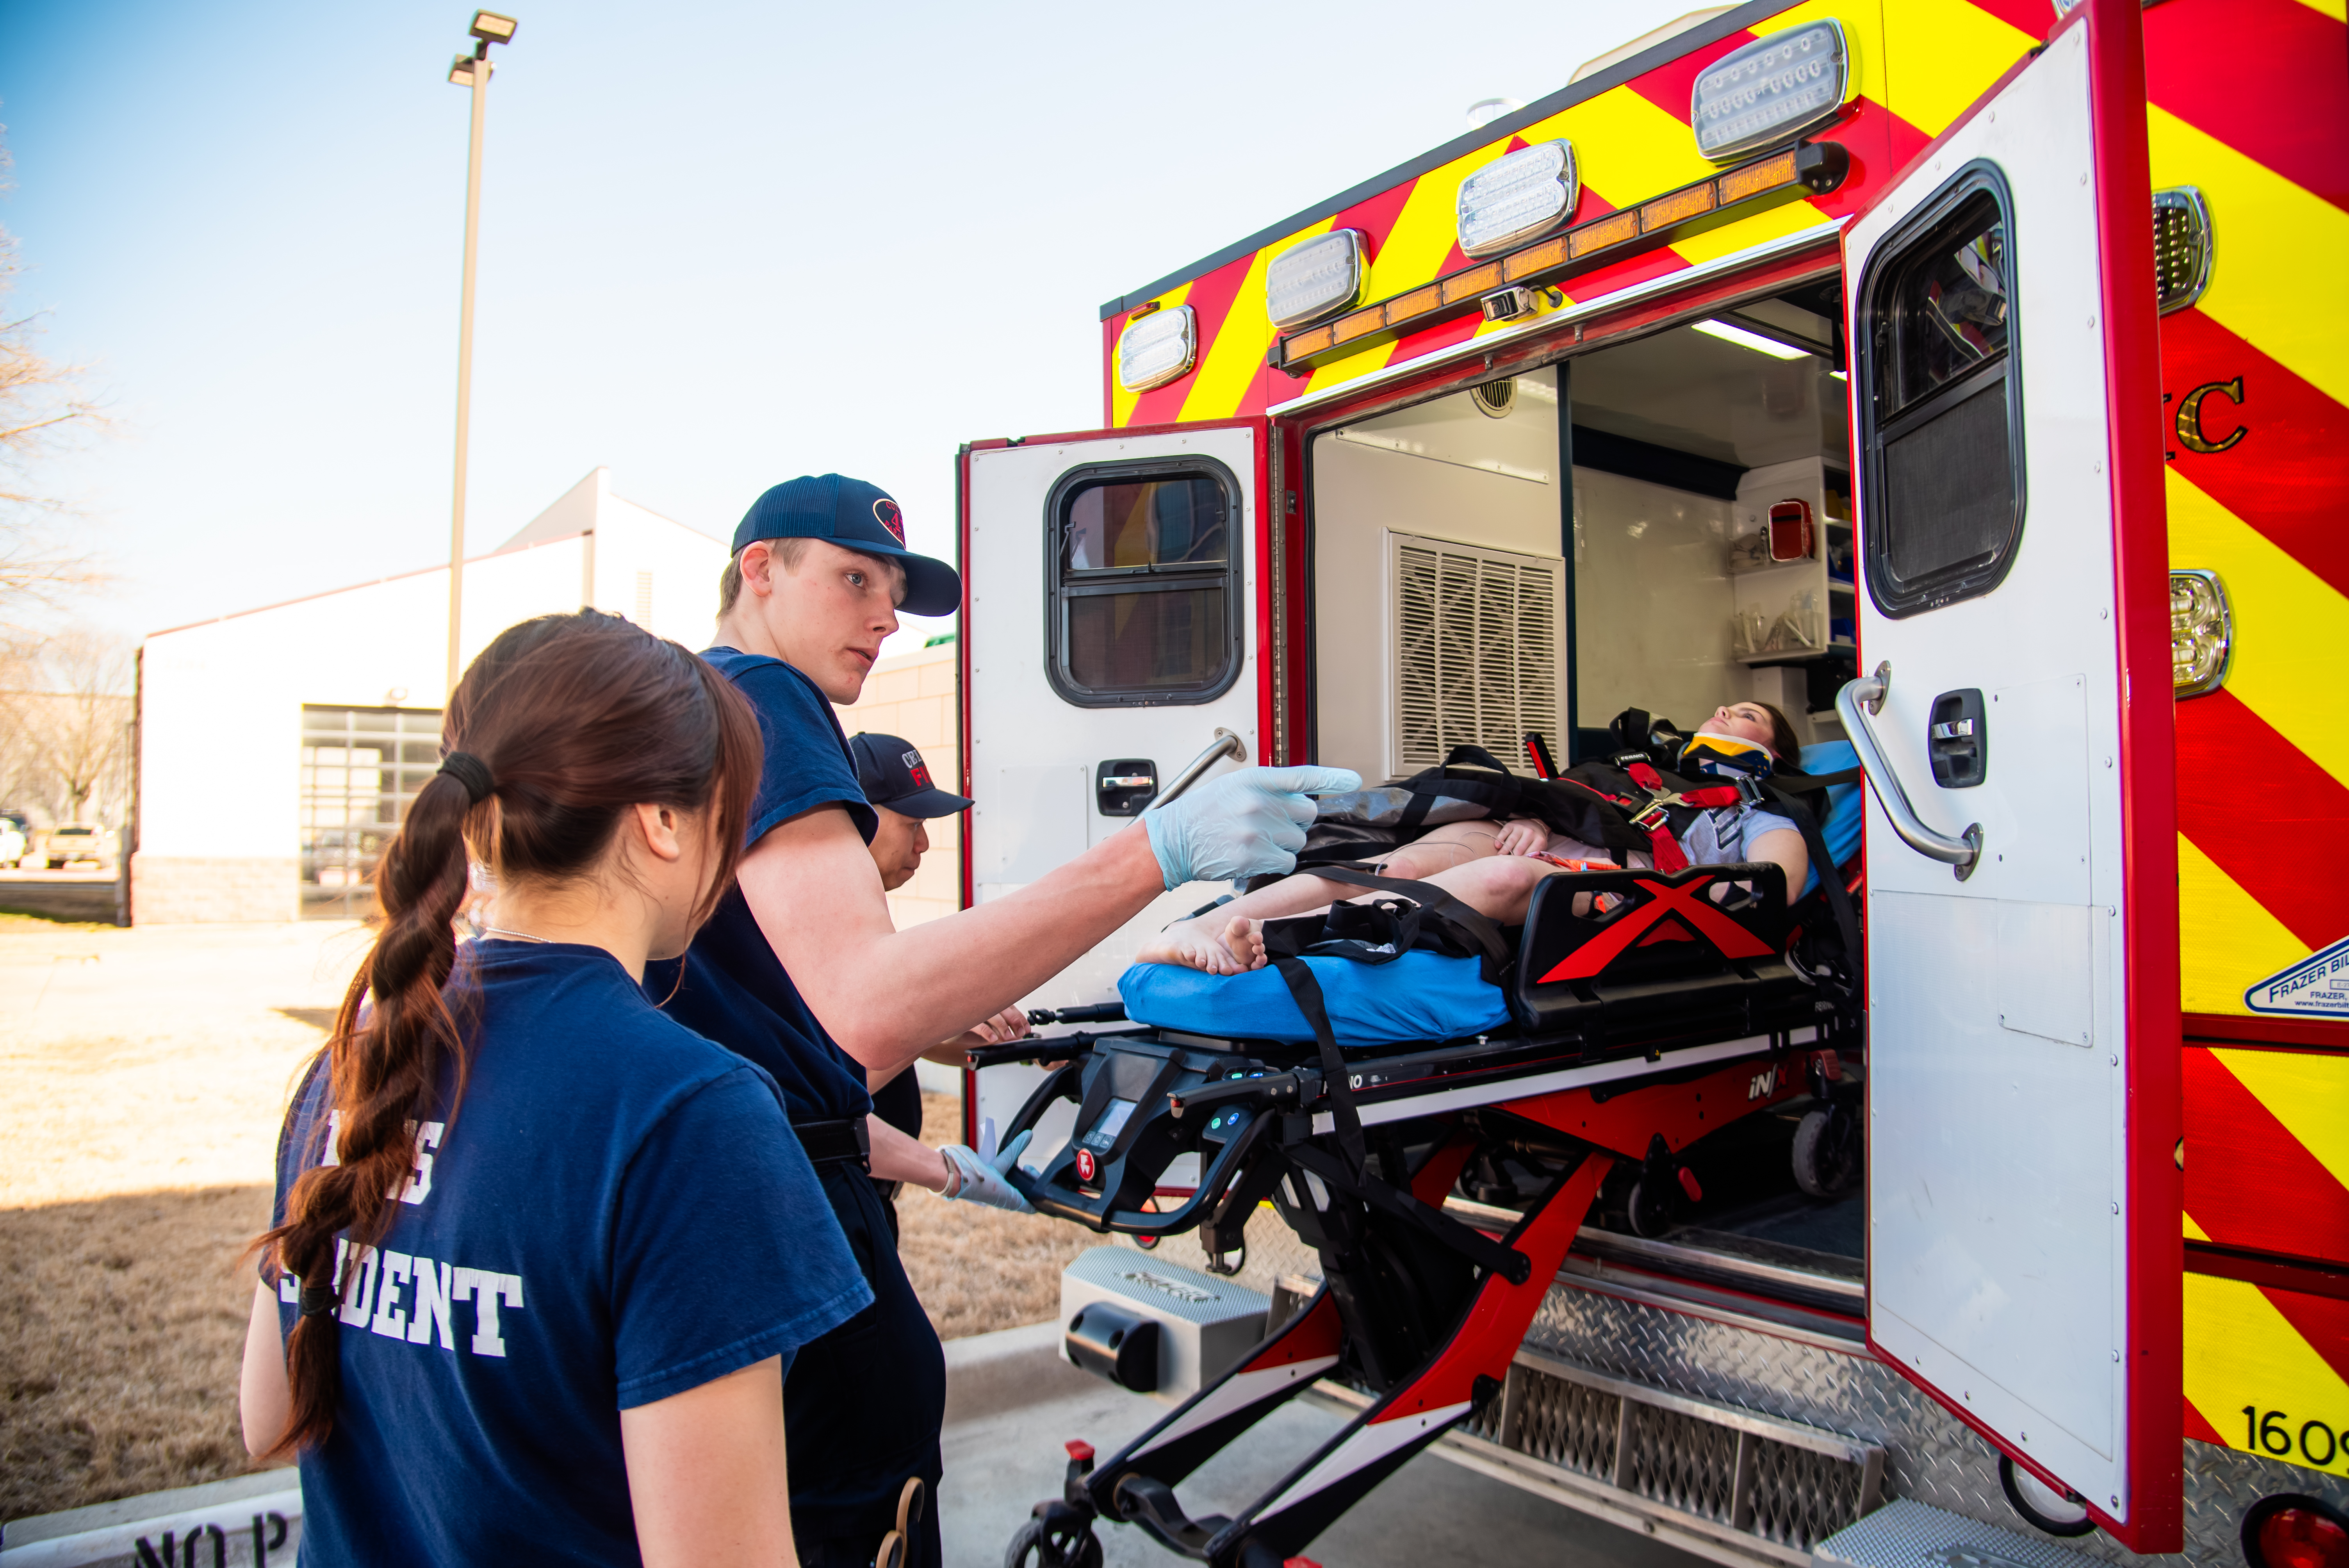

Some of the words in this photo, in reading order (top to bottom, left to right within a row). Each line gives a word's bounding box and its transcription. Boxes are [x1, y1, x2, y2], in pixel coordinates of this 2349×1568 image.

[2269, 966, 2326, 1003] FRAZER
[2310, 991, 2347, 1001] FRAZER,
[2242, 1406, 2349, 1474] 160
[135, 1523, 226, 1568] NO
